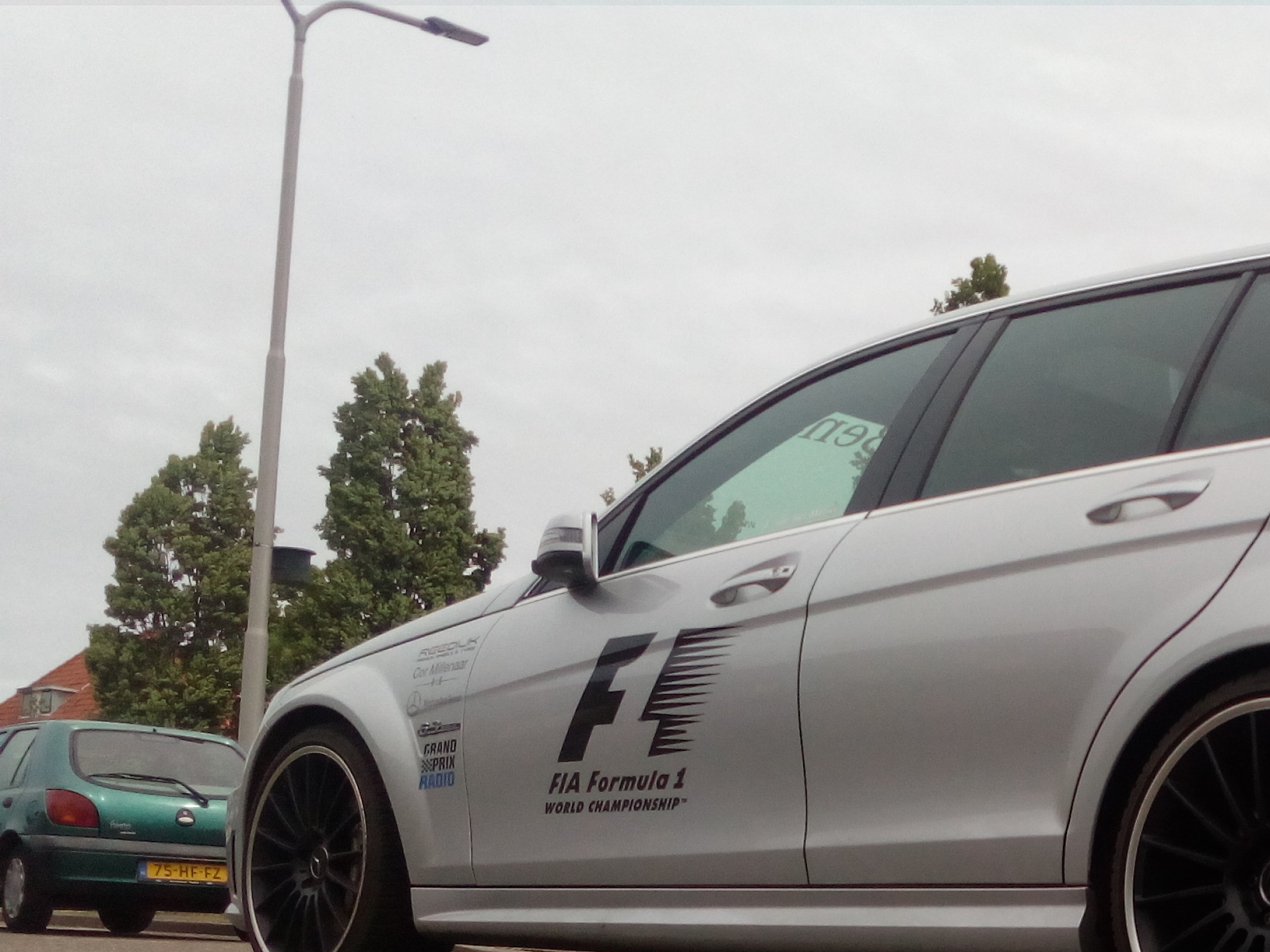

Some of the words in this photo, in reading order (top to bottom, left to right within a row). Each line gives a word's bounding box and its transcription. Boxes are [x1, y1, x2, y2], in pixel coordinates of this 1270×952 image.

[557, 624, 743, 763] F1
[423, 738, 457, 756] GRAND
[432, 755, 456, 772] PRIX
[418, 771, 455, 790] RADIO
[549, 771, 581, 795] FIA
[586, 769, 670, 793] Formula
[673, 766, 687, 790] 1
[545, 801, 585, 815] WORLD
[153, 863, 222, 879] 75-HF-FZ
